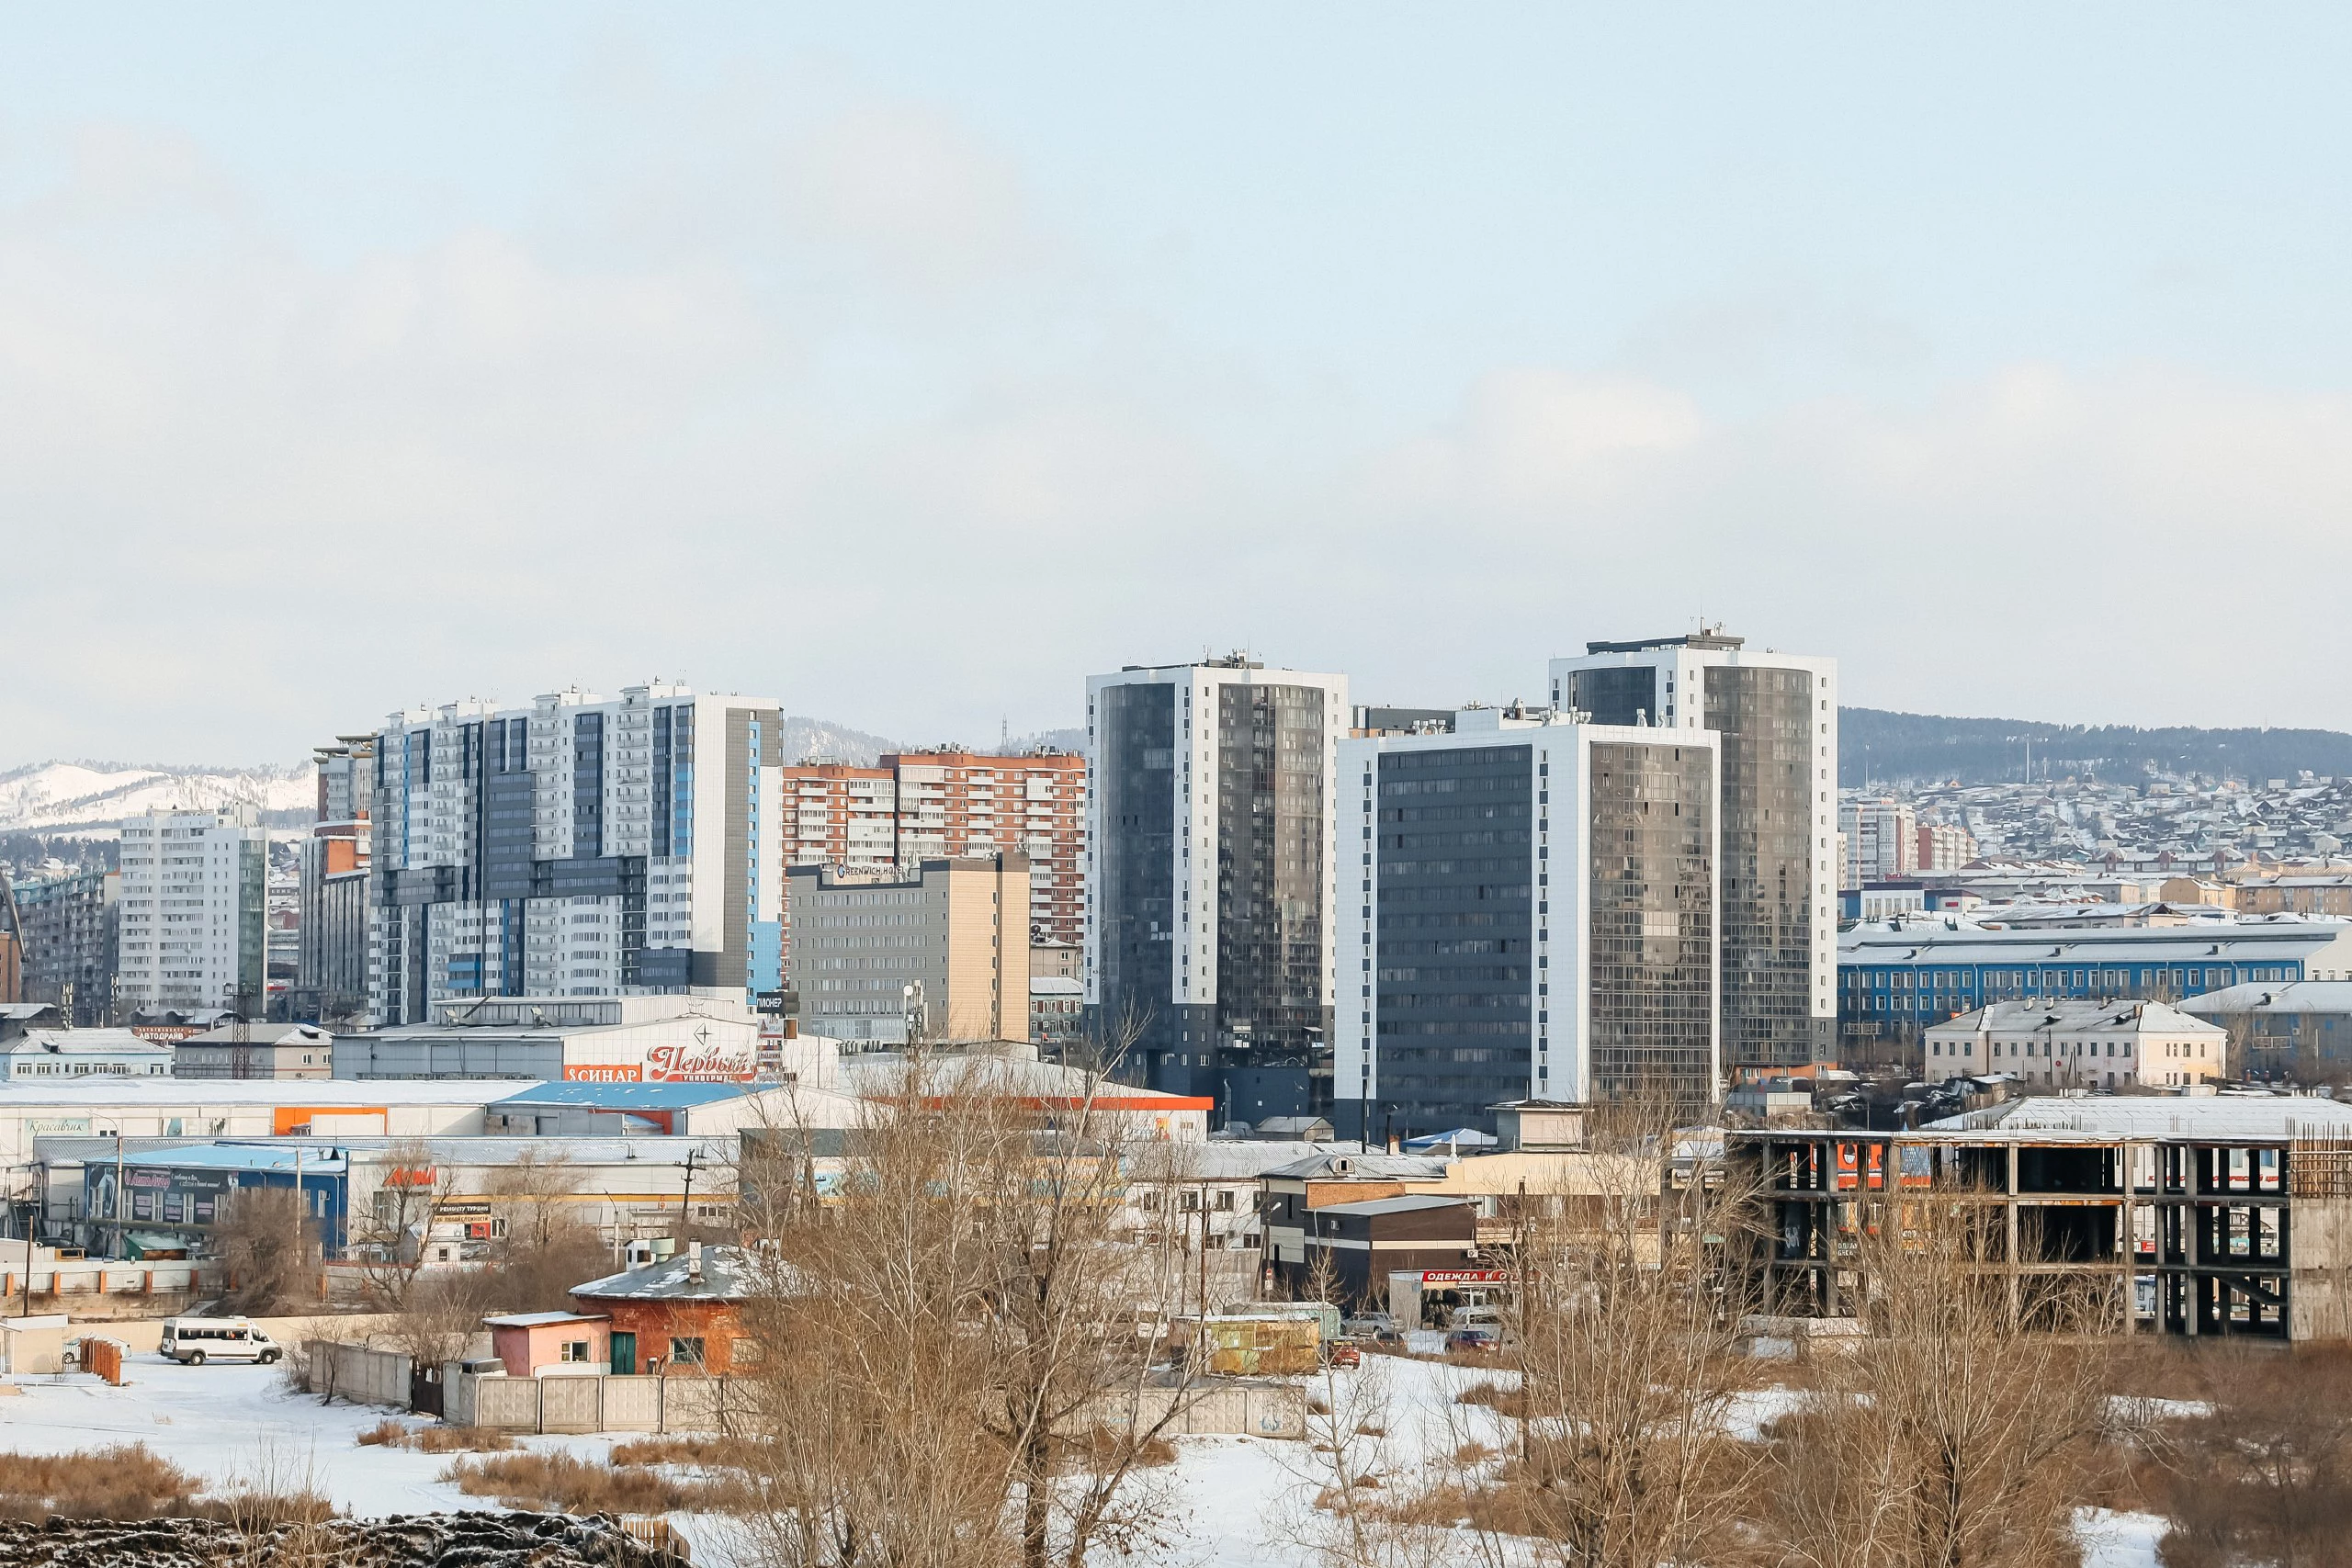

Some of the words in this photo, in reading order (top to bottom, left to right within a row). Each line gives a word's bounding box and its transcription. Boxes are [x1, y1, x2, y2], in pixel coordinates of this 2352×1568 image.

[837, 863, 881, 878] GREENWICH
[757, 998, 782, 1008] ПИОНЕР
[139, 1032, 184, 1040] АВТОДРАЙВ
[649, 1046, 751, 1079] Первый
[578, 1069, 638, 1082] СИНАР
[29, 1120, 84, 1135] Красавчик
[1427, 1272, 1478, 1280] ОДЕЖДА
